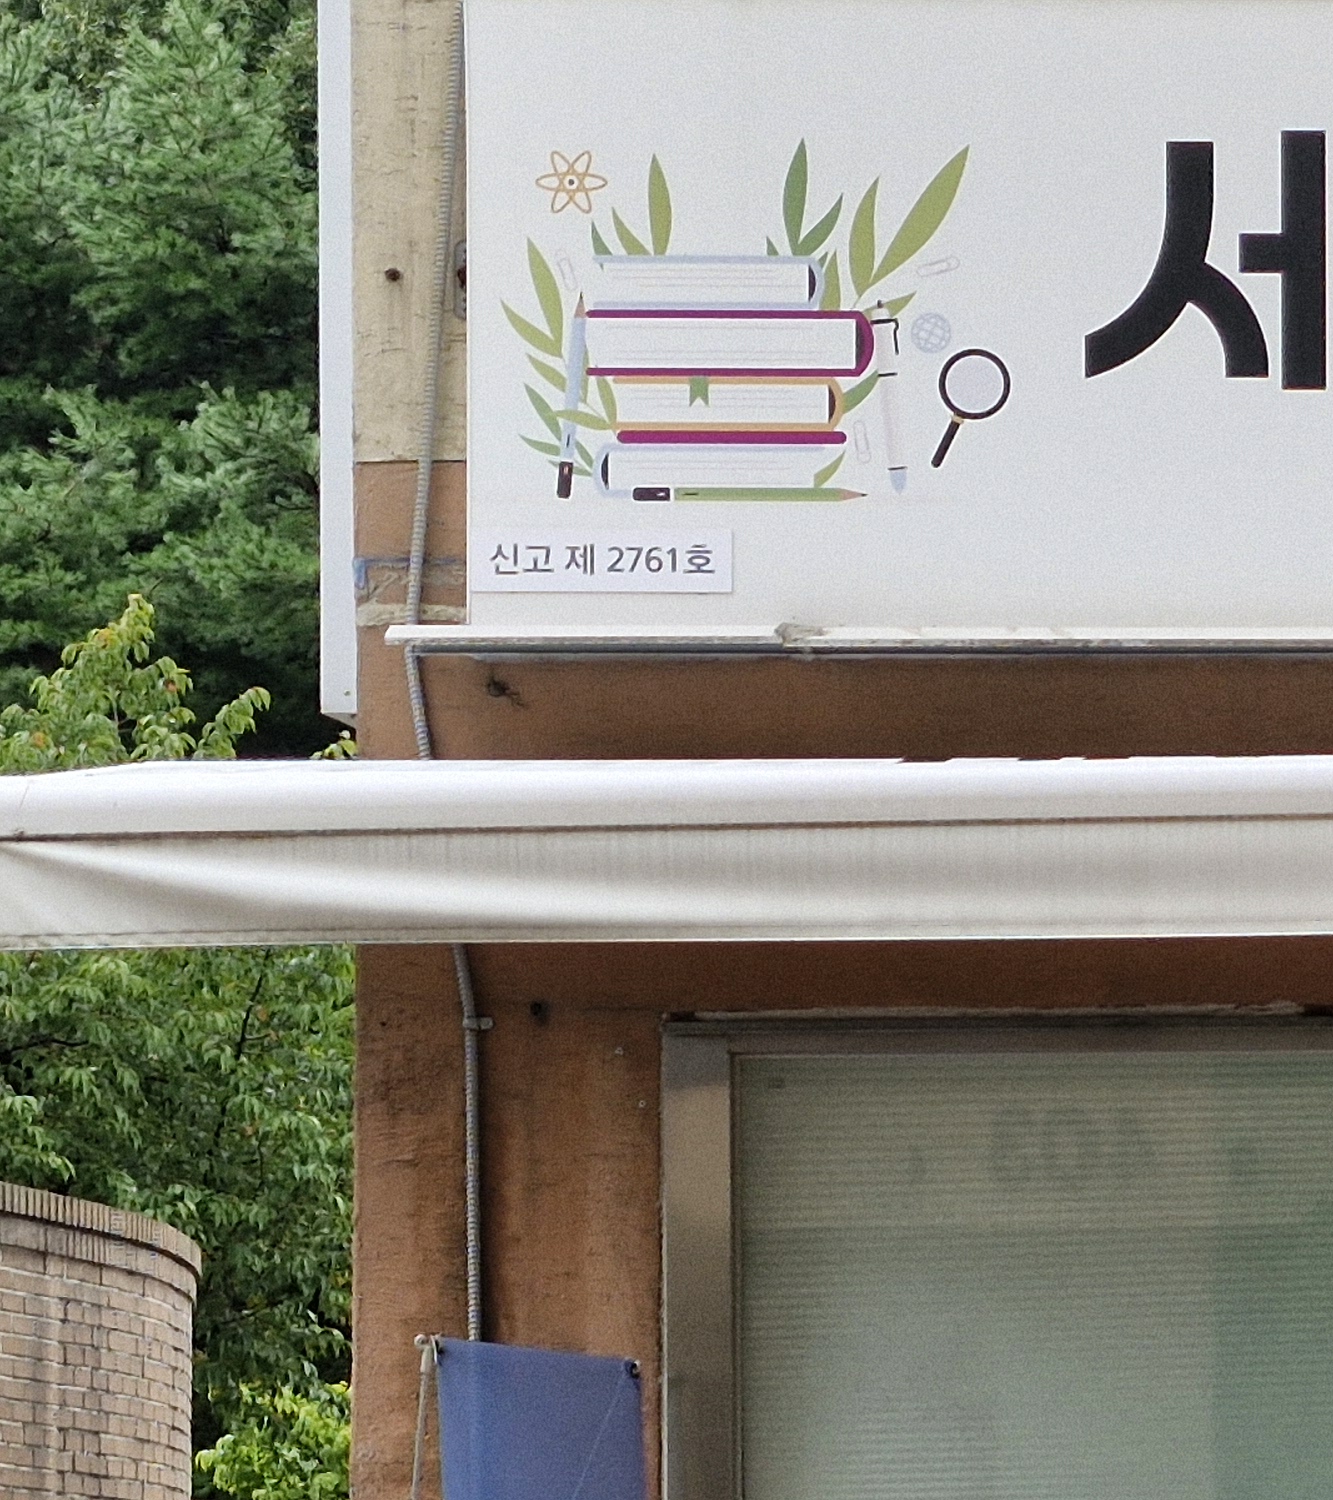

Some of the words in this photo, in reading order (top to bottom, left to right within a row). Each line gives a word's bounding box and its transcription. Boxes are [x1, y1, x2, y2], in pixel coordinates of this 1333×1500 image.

[489, 543, 555, 576] 신고
[564, 543, 596, 576] 제
[606, 543, 716, 575] 2761호
